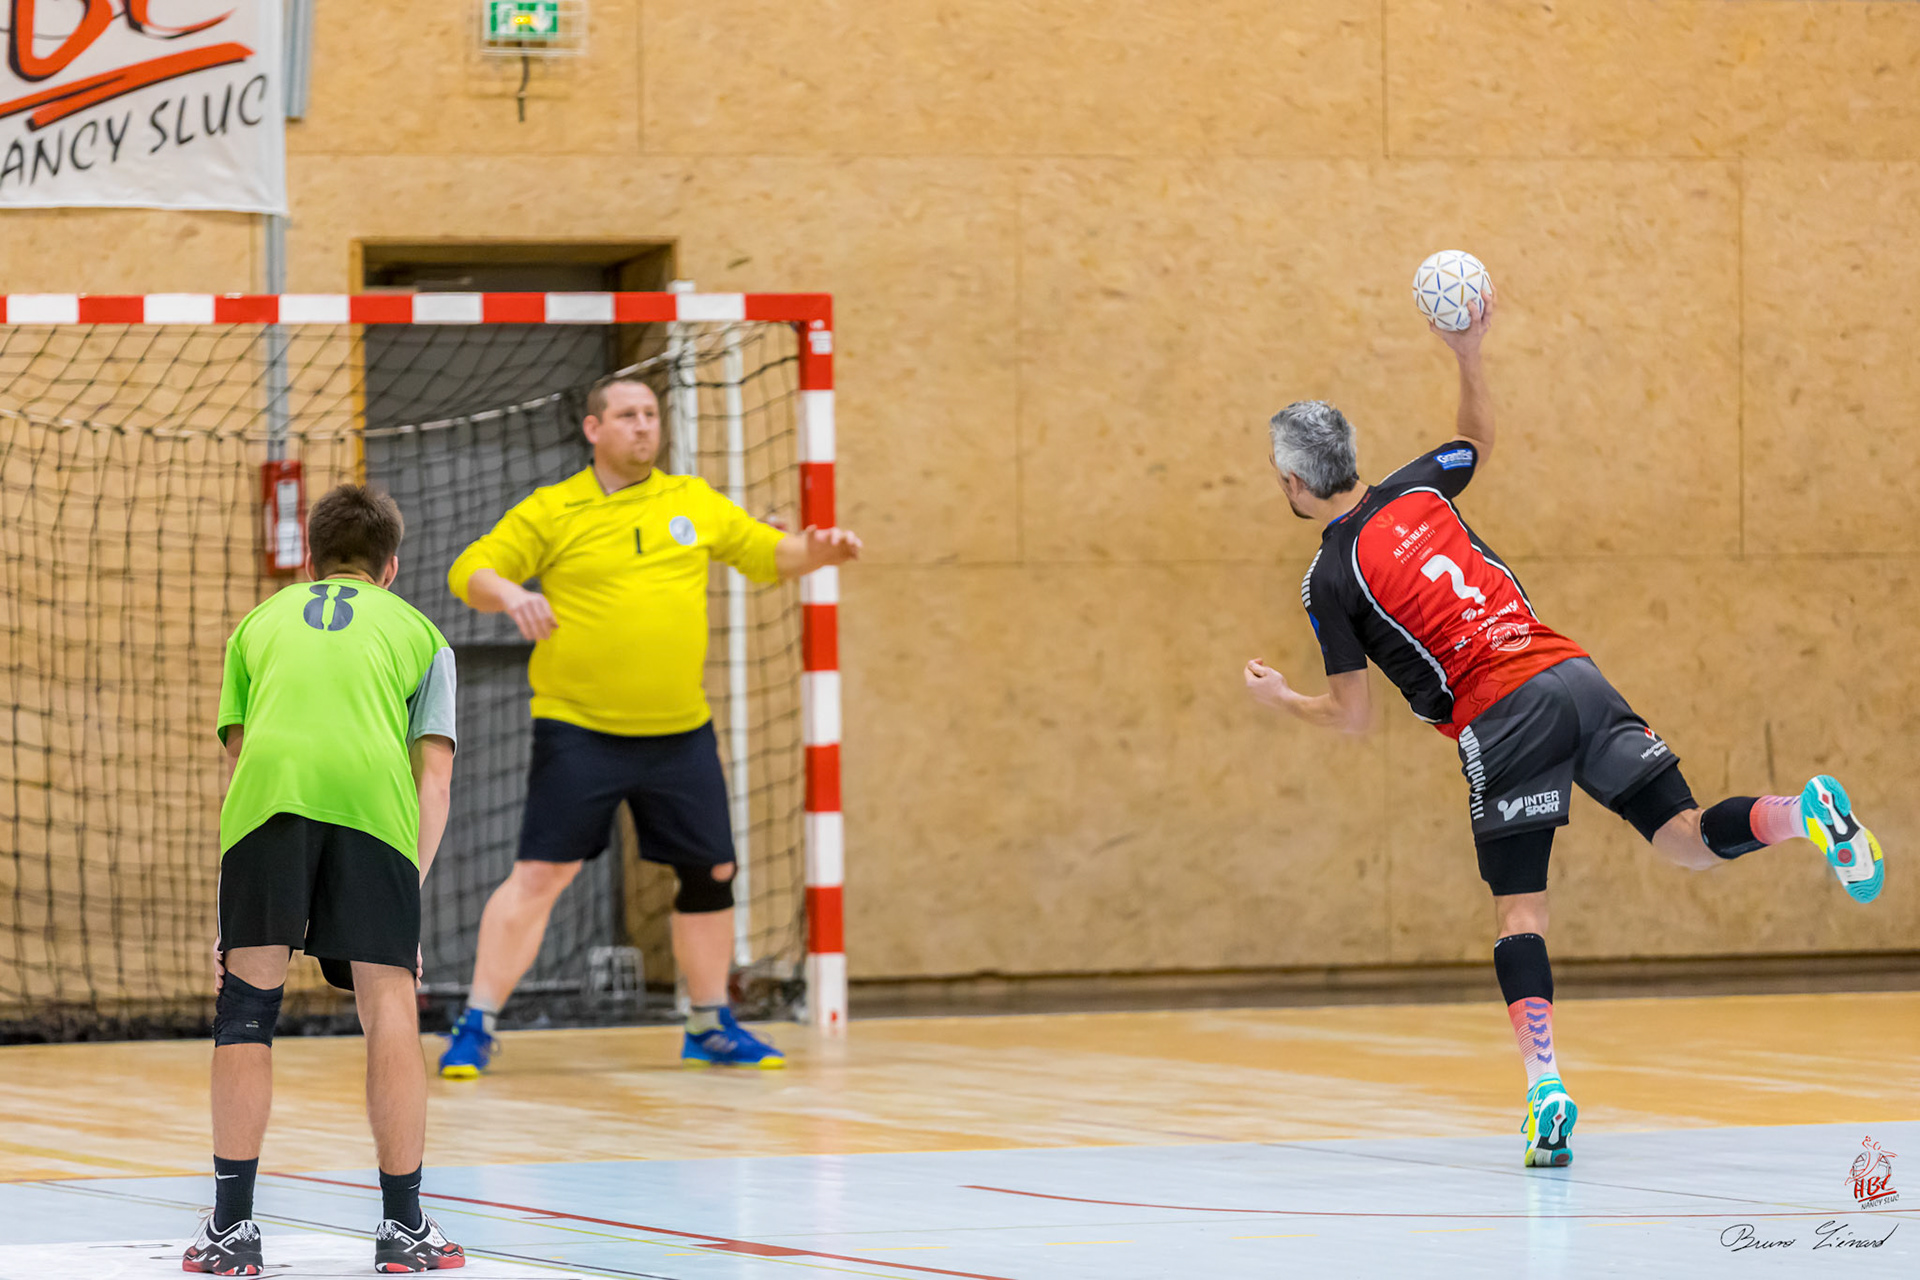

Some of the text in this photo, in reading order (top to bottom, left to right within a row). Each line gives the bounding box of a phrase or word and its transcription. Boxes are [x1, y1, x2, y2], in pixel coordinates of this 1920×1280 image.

[149, 74, 267, 155] SLUC
[634, 527, 643, 554] 1
[1393, 546, 1405, 559] AU
[1403, 522, 1430, 549] BUREAU
[1420, 554, 1487, 613] 7
[303, 584, 359, 631] 8
[1524, 790, 1559, 807] INTER
[1526, 801, 1560, 817] SPORT
